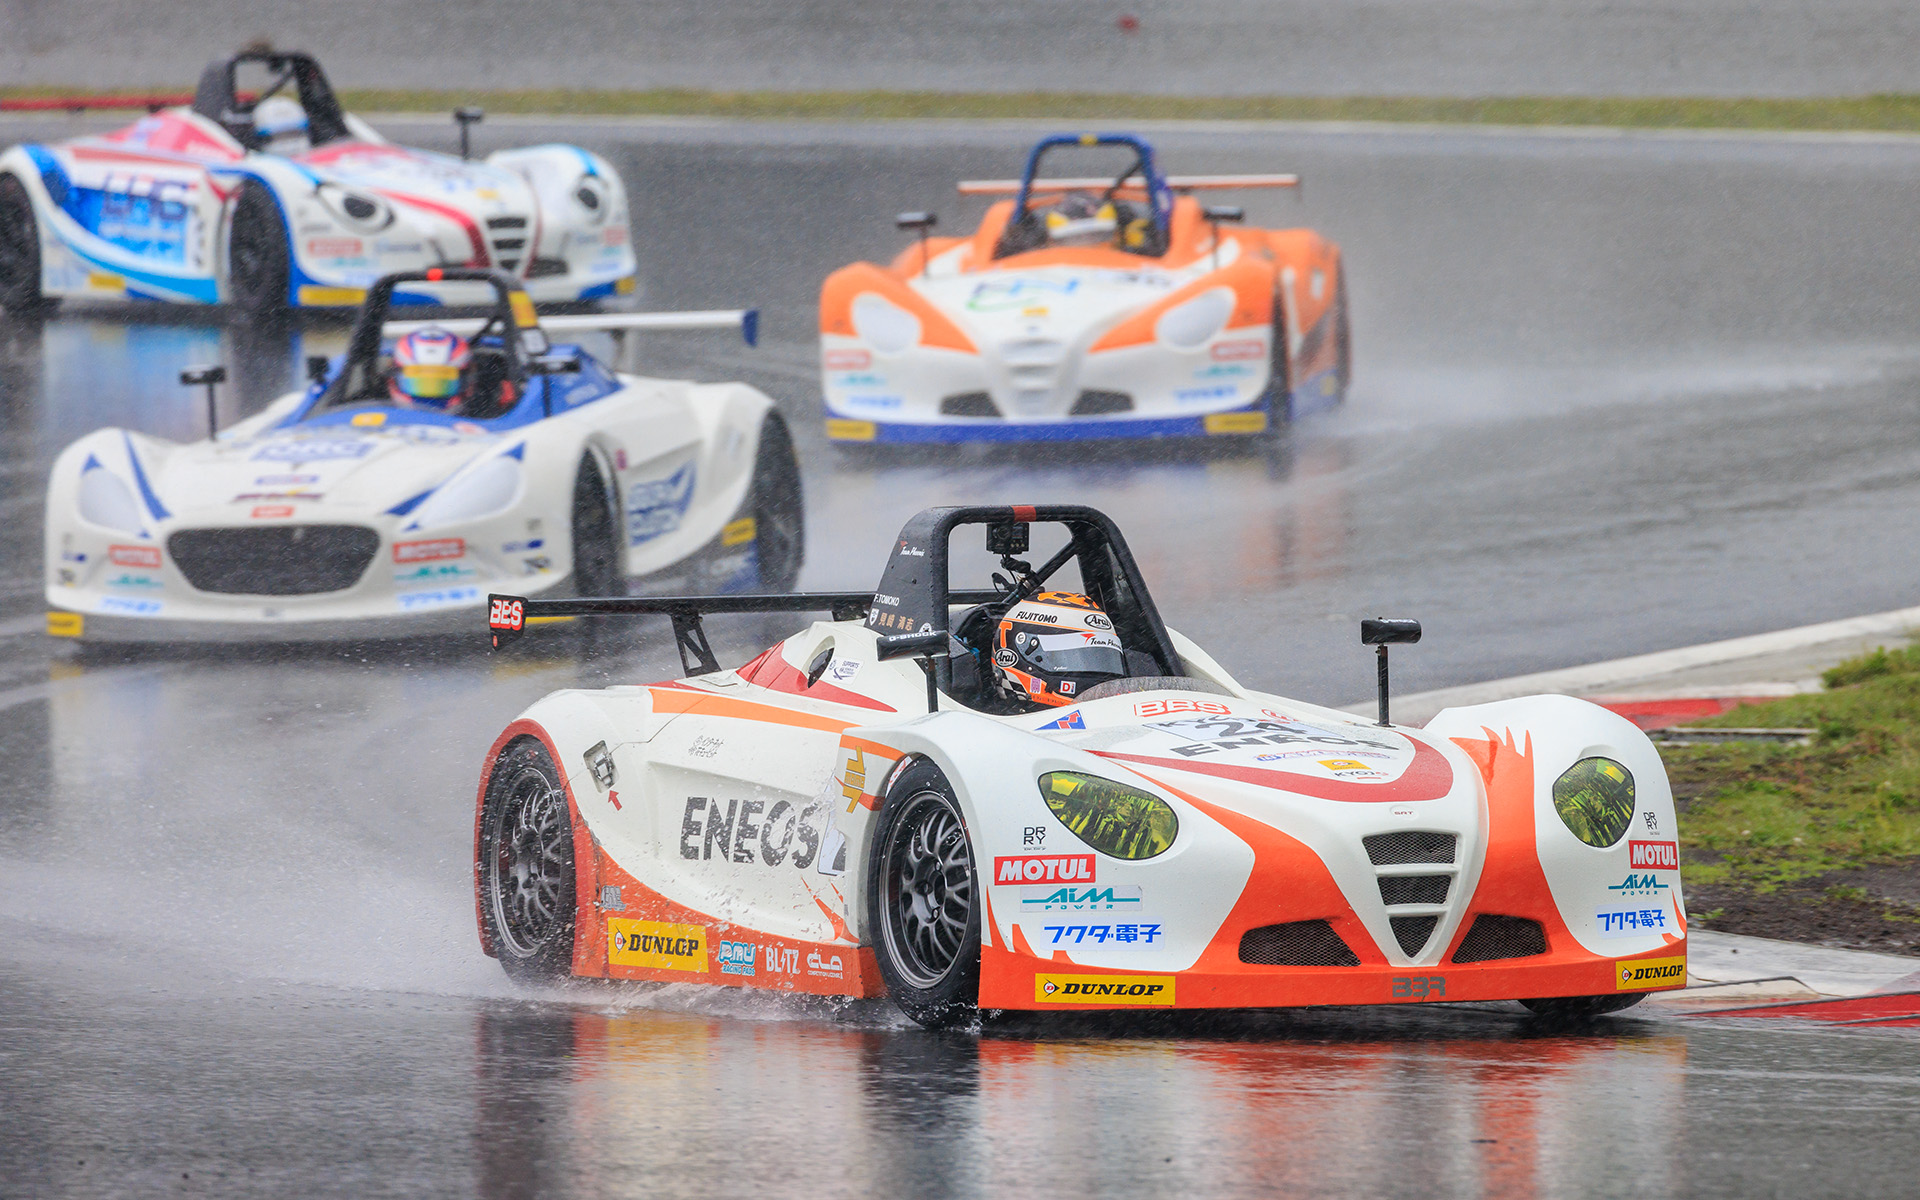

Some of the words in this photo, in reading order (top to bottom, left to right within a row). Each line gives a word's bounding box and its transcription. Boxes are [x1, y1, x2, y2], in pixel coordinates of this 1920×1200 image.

[490, 600, 523, 630] BBS
[1015, 611, 1058, 624] FUJITOMO
[1089, 614, 1110, 627] Arai
[1091, 638, 1106, 646] Team
[995, 651, 1013, 662] Arai
[1134, 699, 1231, 717] BBS
[1194, 721, 1309, 738] 24
[1169, 734, 1400, 757] ENEOS
[679, 796, 820, 870] ENEOS
[1632, 844, 1676, 867] MOTUL
[998, 858, 1092, 882] MOTUL
[1597, 909, 1666, 932] フクダ電子
[1044, 924, 1162, 944] フクダ電子
[628, 934, 699, 957] DUNLOP
[1634, 964, 1684, 980] DUNLOP
[1062, 983, 1164, 997] DUNLOP
